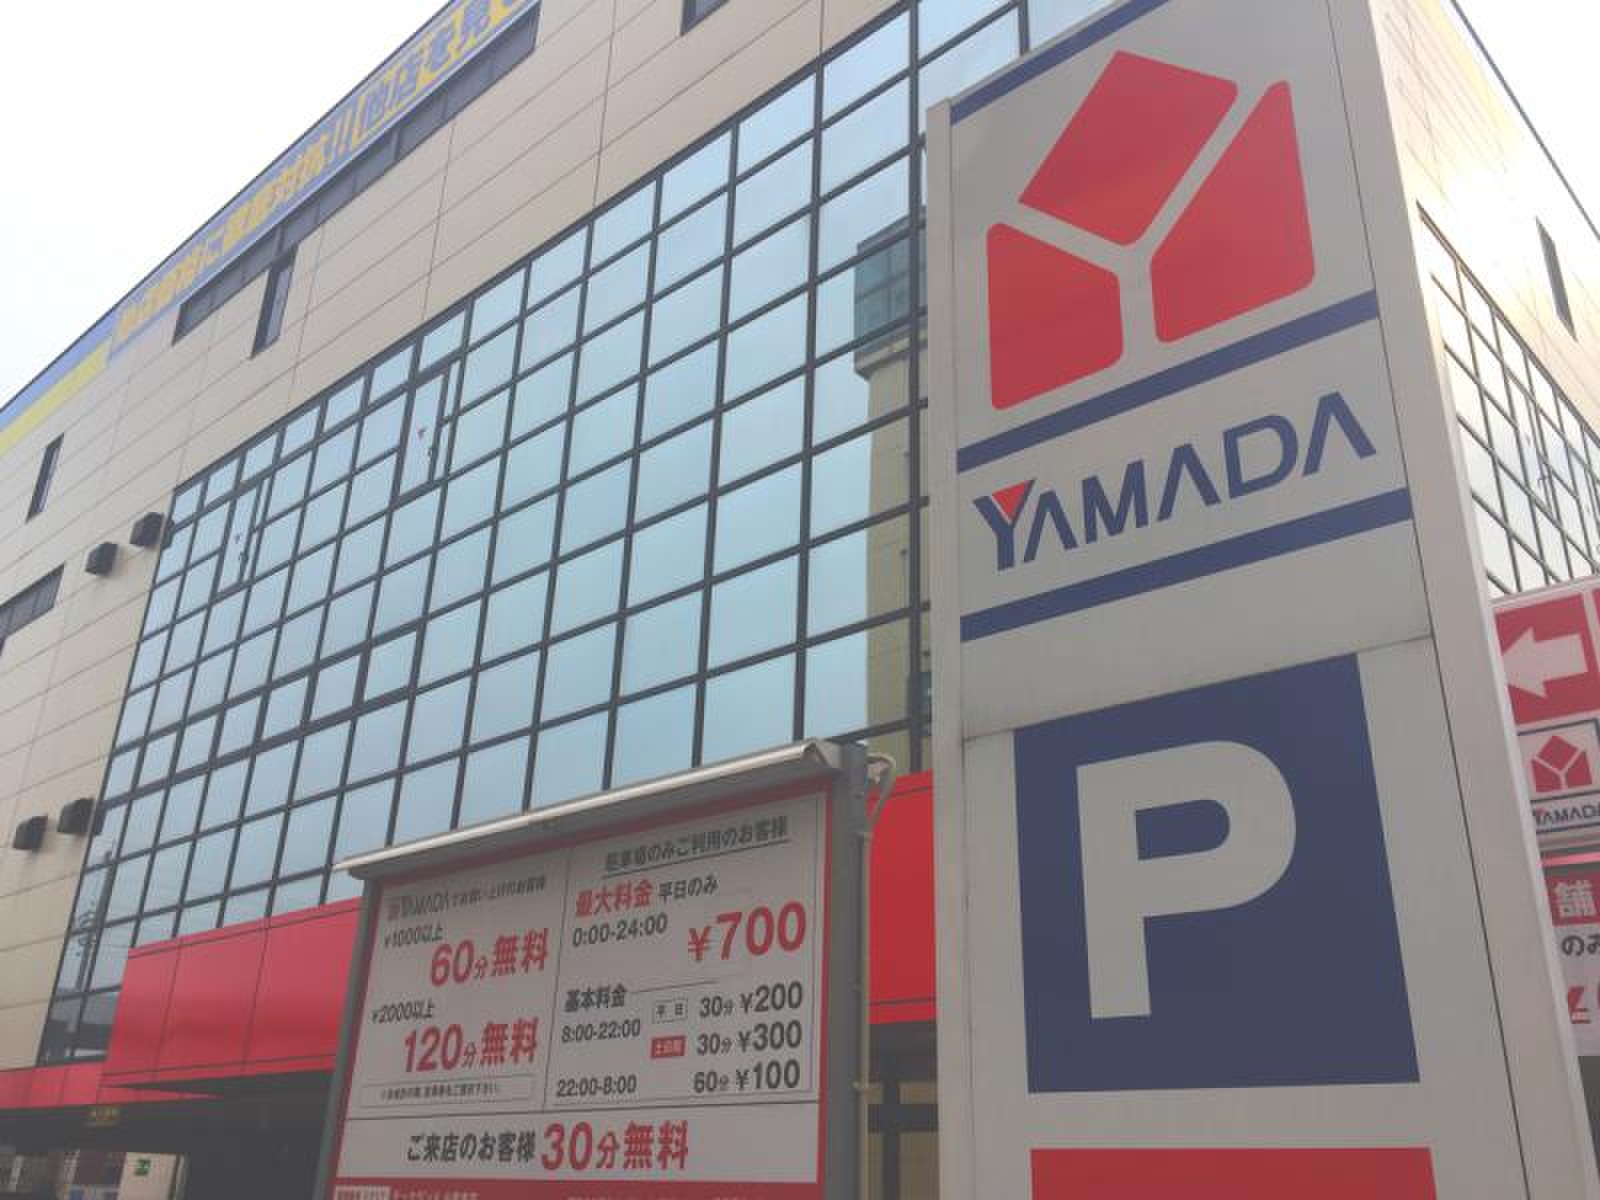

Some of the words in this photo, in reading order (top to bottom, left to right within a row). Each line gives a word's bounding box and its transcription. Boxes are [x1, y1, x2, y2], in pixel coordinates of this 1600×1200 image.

[973, 391, 1376, 571] YAMADA
[1532, 800, 1600, 826] YAMAD
[575, 879, 653, 918] 最大料金
[657, 874, 719, 904] 平日のみ
[1076, 740, 1296, 1019] P
[572, 913, 668, 948] 0:00-24:00
[687, 900, 807, 962] ¥700
[431, 926, 548, 987] 60分無料
[564, 983, 627, 1014] 基本料金
[404, 1016, 538, 1073] 120分無料
[561, 1018, 641, 1044] 8:00-22:00
[556, 1074, 637, 1098] 22:00-8:00
[407, 1130, 536, 1163] ご来店のお客様
[541, 1119, 689, 1171] 30分無料
